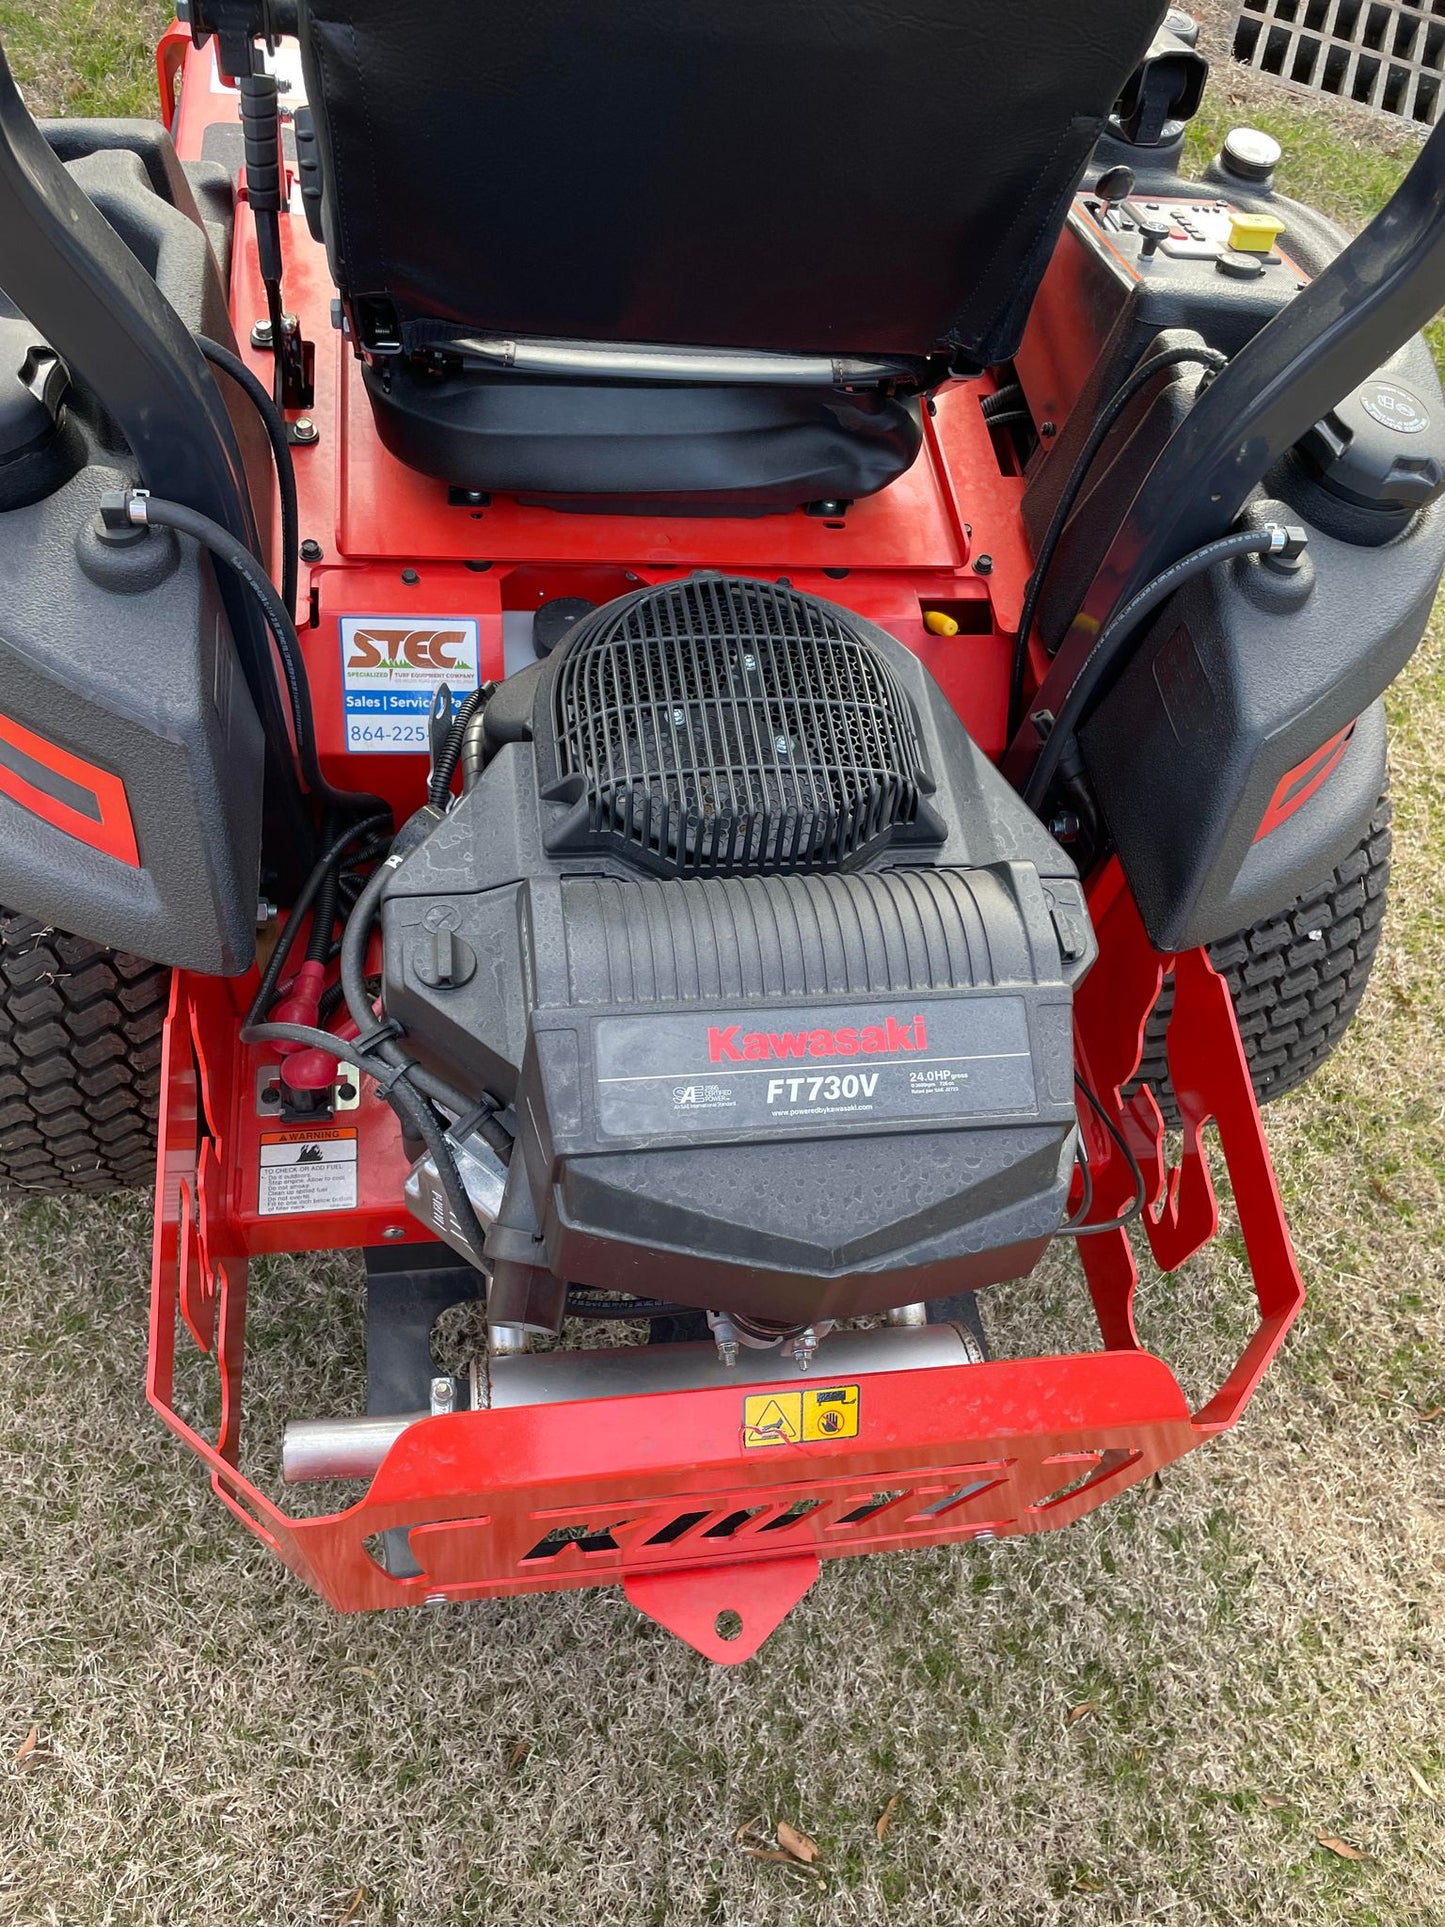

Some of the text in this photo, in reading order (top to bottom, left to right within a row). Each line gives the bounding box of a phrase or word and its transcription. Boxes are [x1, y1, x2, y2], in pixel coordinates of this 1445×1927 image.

[347, 629, 467, 669] STEC
[346, 696, 432, 708] Sales Servic
[707, 1015, 928, 1063] Kawasaki
[672, 1085, 704, 1104] SAE
[766, 1073, 879, 1104] FT730V
[771, 1103, 873, 1117] www.poweredbykawasaki.com
[289, 1130, 340, 1140] WARNING
